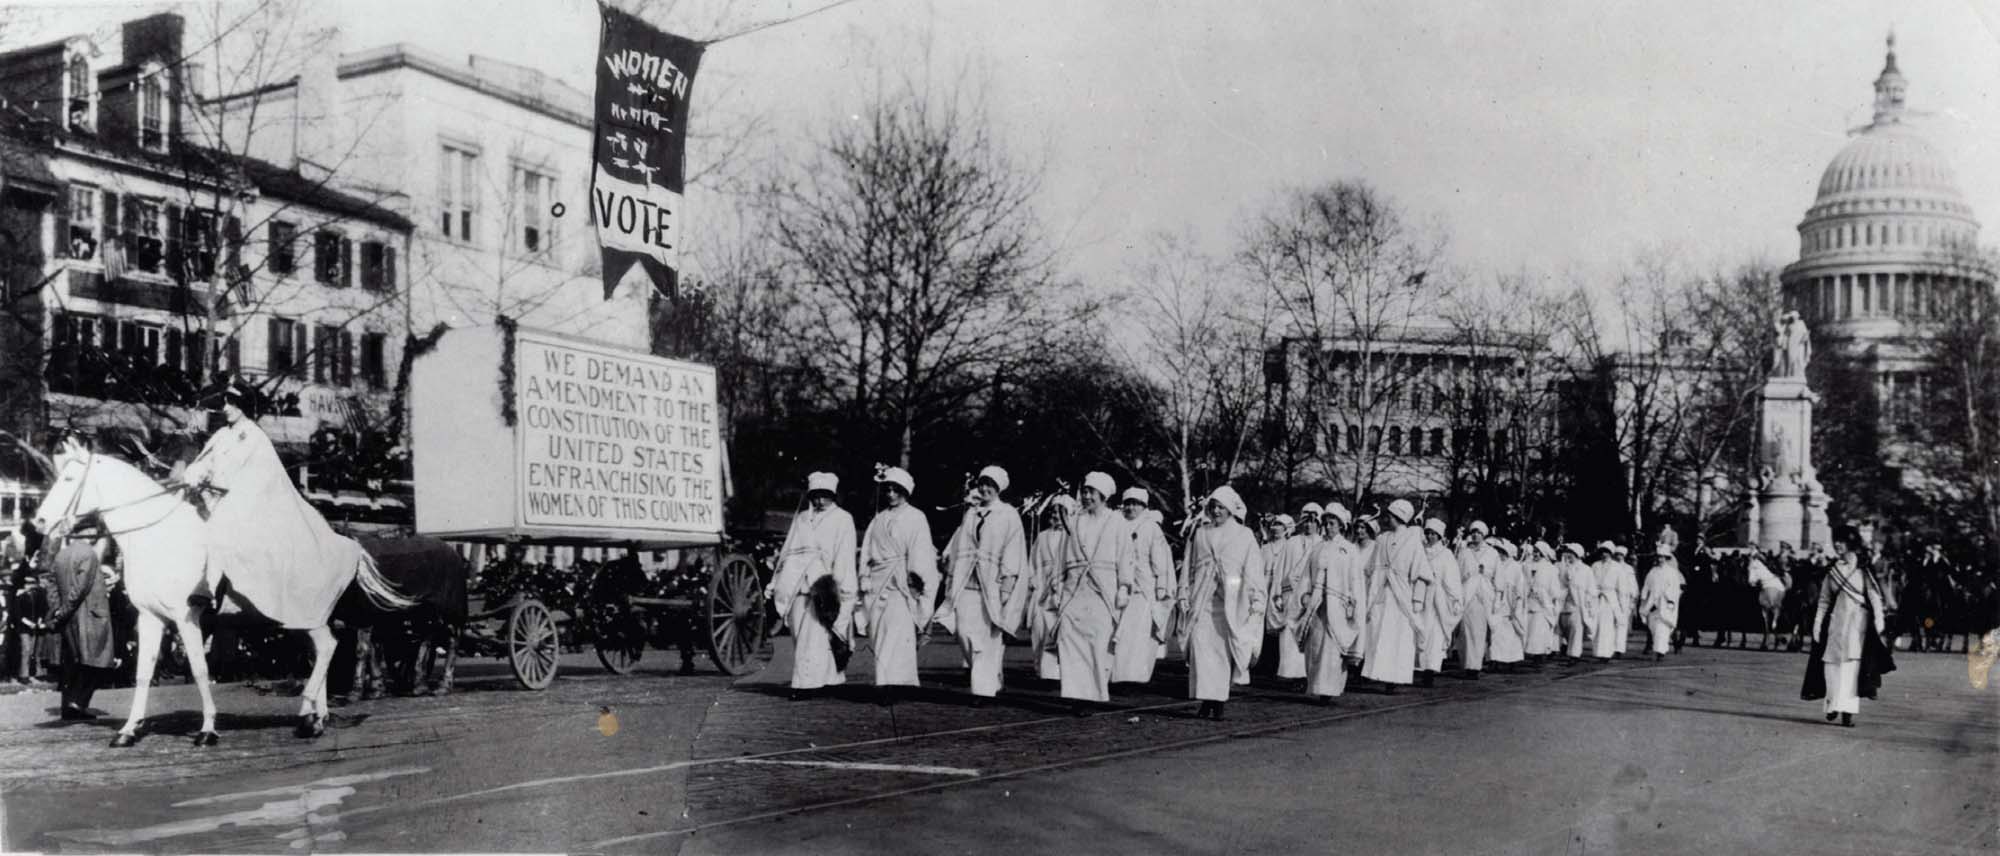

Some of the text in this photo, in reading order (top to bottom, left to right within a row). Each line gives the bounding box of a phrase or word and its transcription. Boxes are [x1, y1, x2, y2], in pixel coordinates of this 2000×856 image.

[605, 48, 688, 100] WOMEN
[596, 187, 672, 250] VOTE
[544, 350, 703, 395] WE DEMAND AN
[526, 375, 711, 424] AMENDMENT TO THE
[527, 404, 712, 449] CONSTITUTION OF THE
[549, 434, 703, 474] UNITED STATES
[529, 462, 713, 500] ENFRANCHISING THE
[528, 491, 712, 524] WOMEN OF THIS COUNTRY
